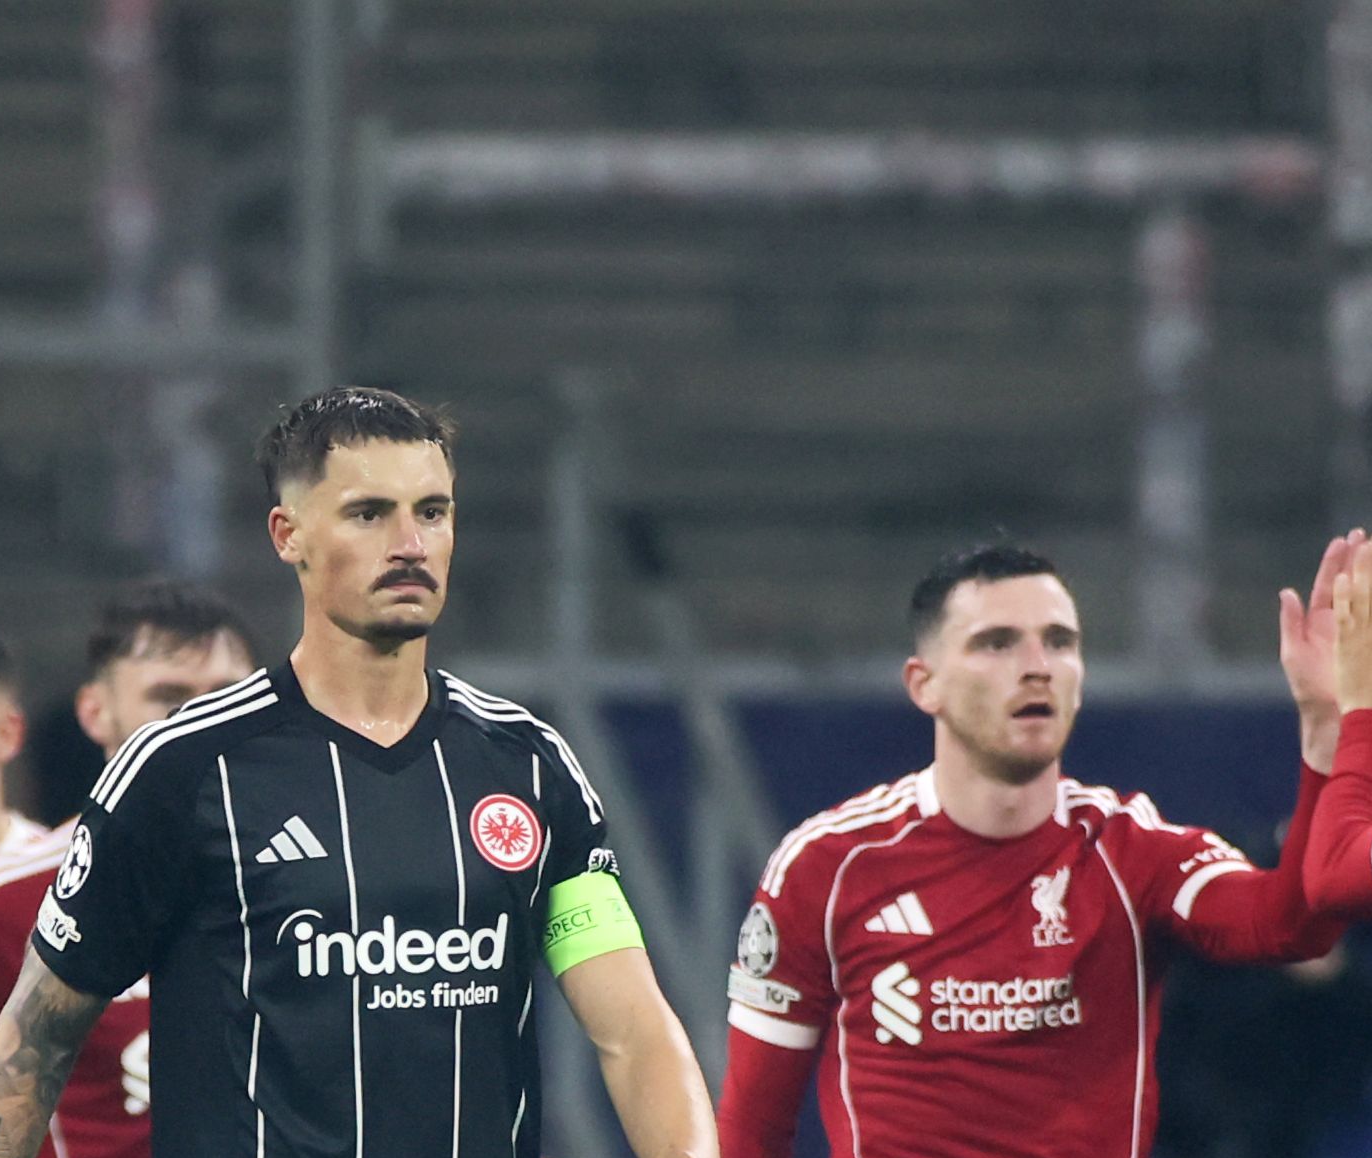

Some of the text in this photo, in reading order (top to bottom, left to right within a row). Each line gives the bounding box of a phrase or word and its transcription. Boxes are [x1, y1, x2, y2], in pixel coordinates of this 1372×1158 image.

[294, 912, 509, 978] indeed
[367, 980, 499, 1010] Jobs finden
[930, 975, 1073, 1005] standard
[931, 998, 1082, 1032] chartered
